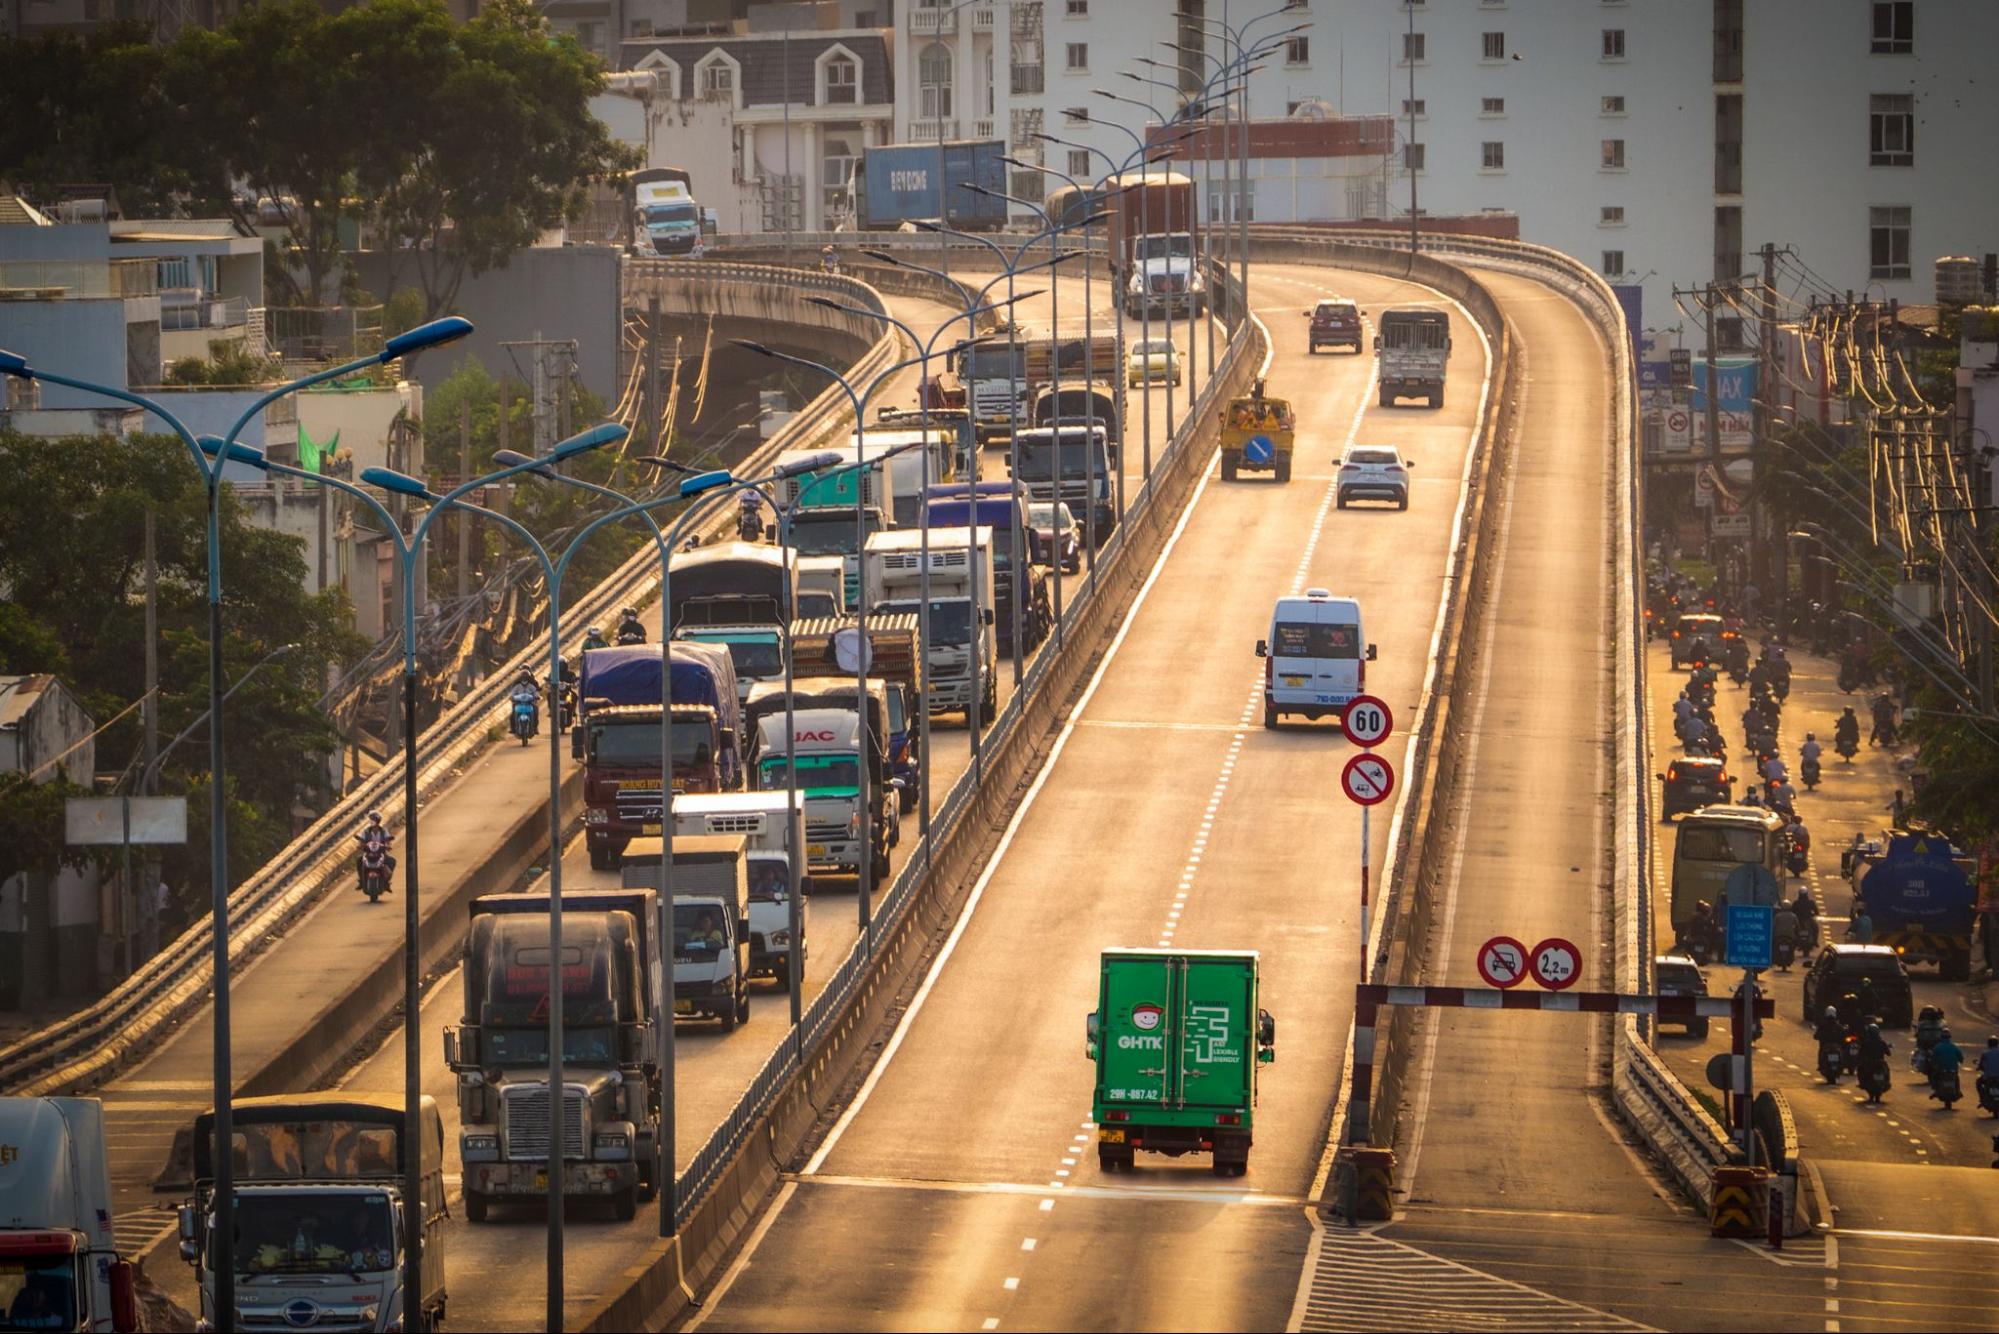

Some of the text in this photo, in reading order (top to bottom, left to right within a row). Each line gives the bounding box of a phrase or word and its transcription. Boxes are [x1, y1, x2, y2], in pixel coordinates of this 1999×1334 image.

[1356, 710, 1380, 732] 60
[795, 731, 835, 742] JAC
[1118, 1035, 1162, 1049] GHTK
